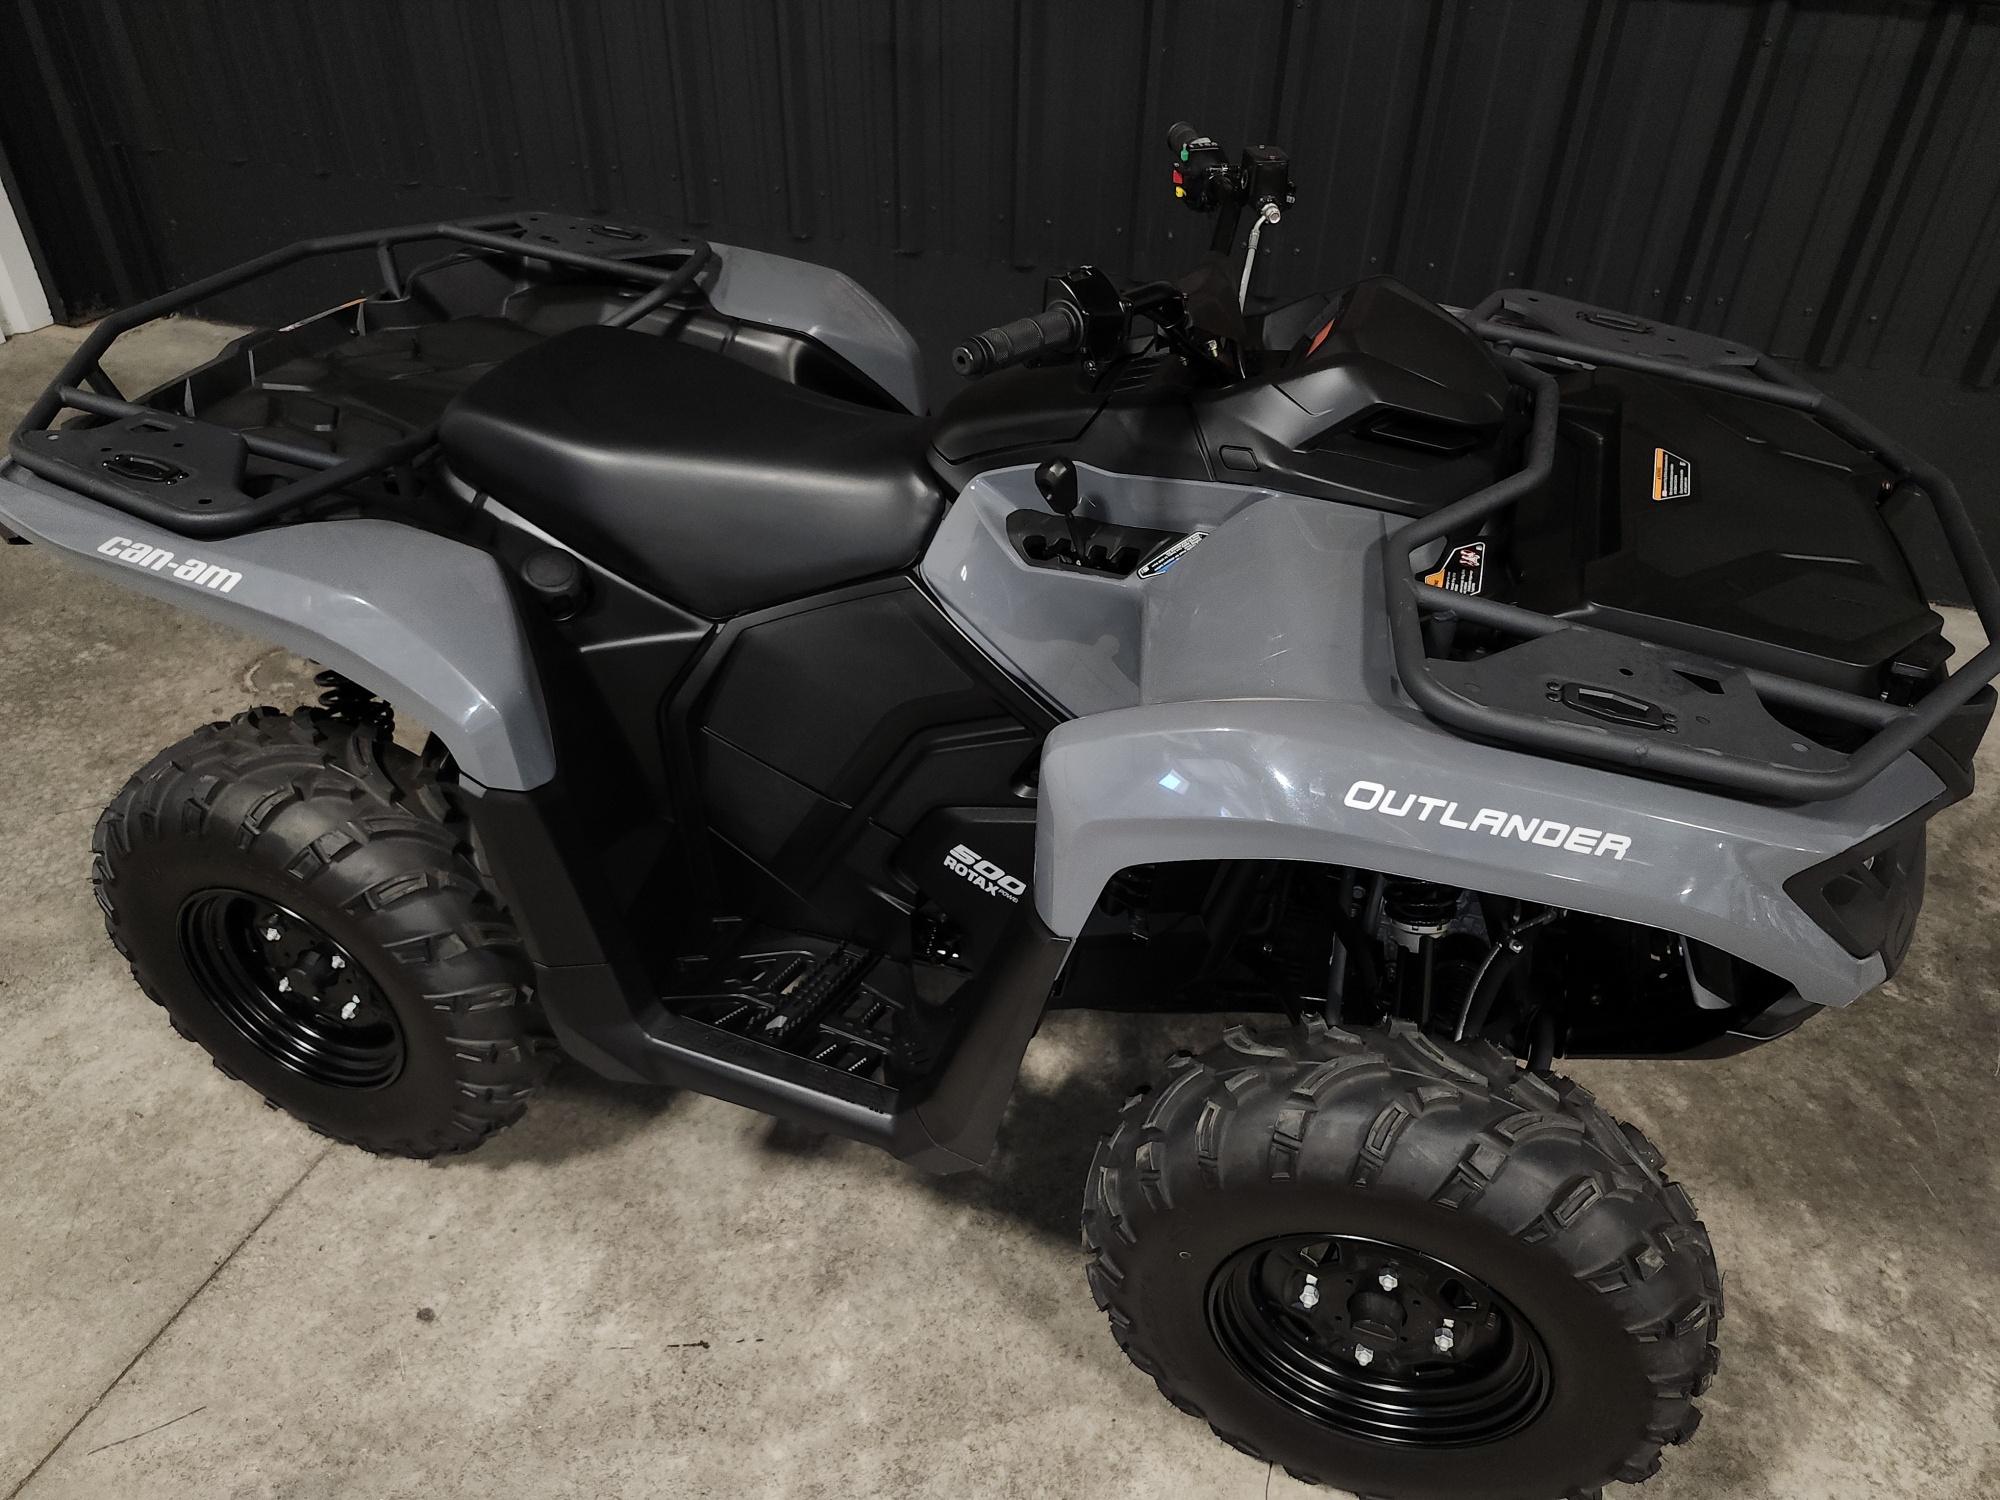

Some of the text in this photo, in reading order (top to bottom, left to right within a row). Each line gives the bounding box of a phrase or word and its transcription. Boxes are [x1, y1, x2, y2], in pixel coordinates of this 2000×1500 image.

[97, 536, 243, 594] can-am
[1343, 780, 1632, 861] OUTLANDER
[943, 854, 999, 897] ROTAX
[949, 843, 1027, 896] 500
